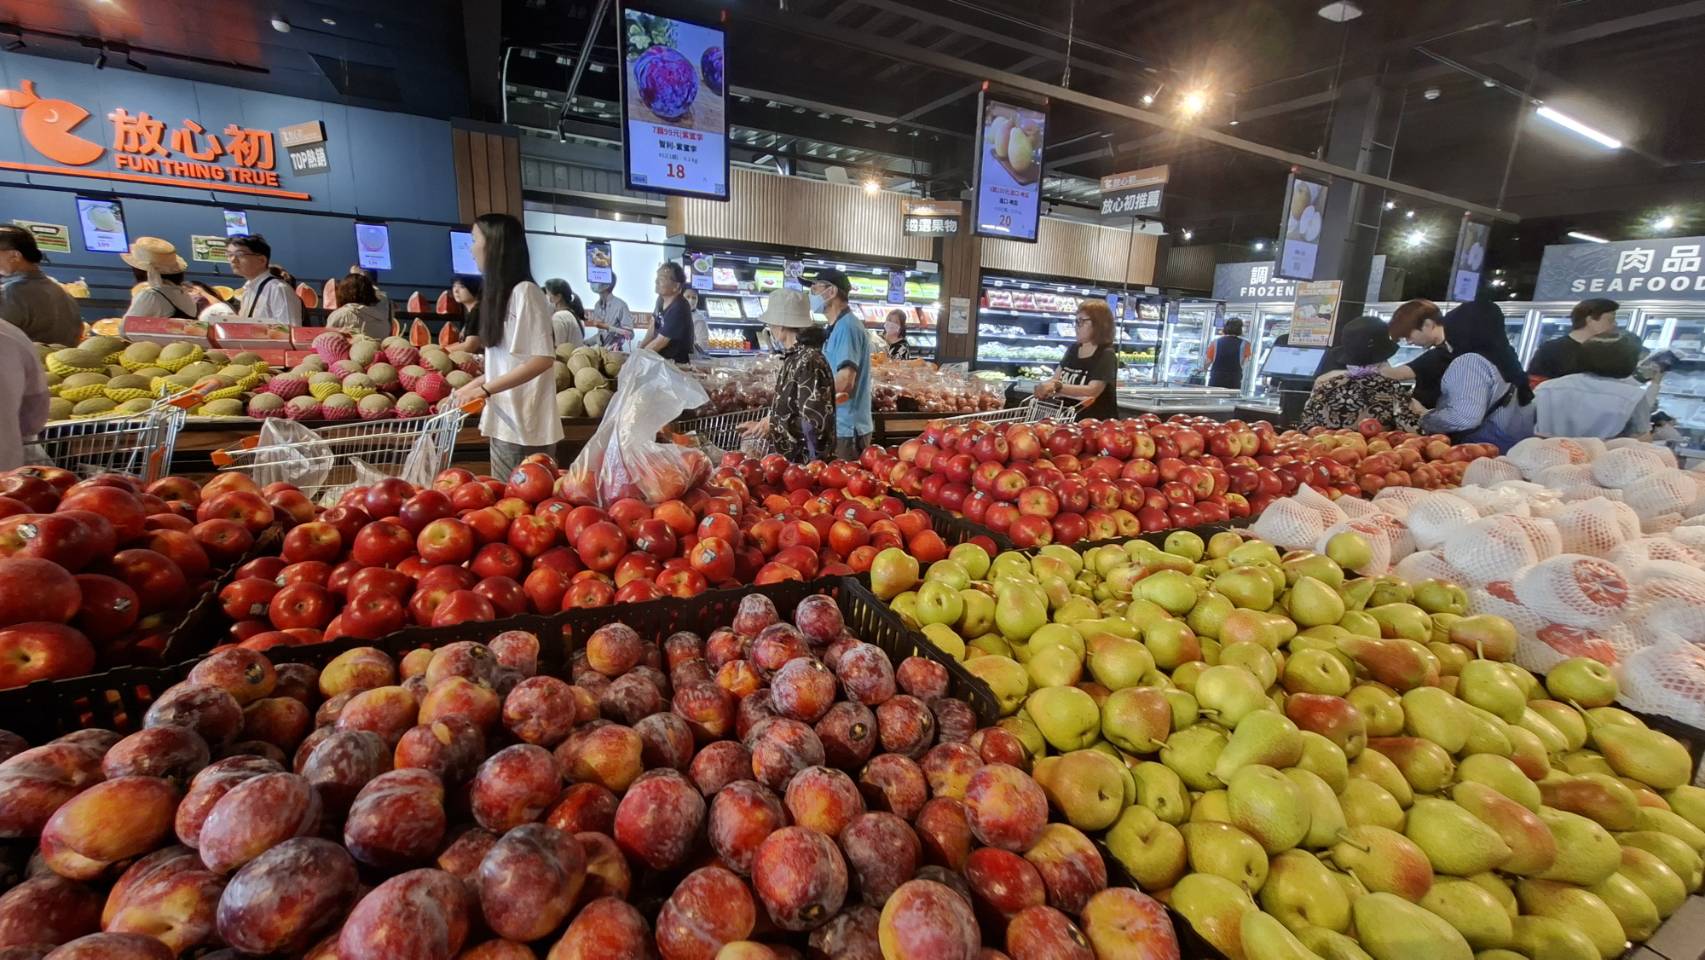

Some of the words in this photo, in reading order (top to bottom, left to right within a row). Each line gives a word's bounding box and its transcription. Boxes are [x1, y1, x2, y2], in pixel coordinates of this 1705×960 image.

[107, 107, 276, 170] 放心初
[115, 154, 160, 174] FUN
[162, 160, 227, 181] THING
[227, 168, 280, 187] TRUE
[666, 163, 685, 179] 18
[1000, 214, 1012, 226] 20
[1615, 244, 1702, 275] 肉品
[1240, 285, 1295, 297] FROZEN
